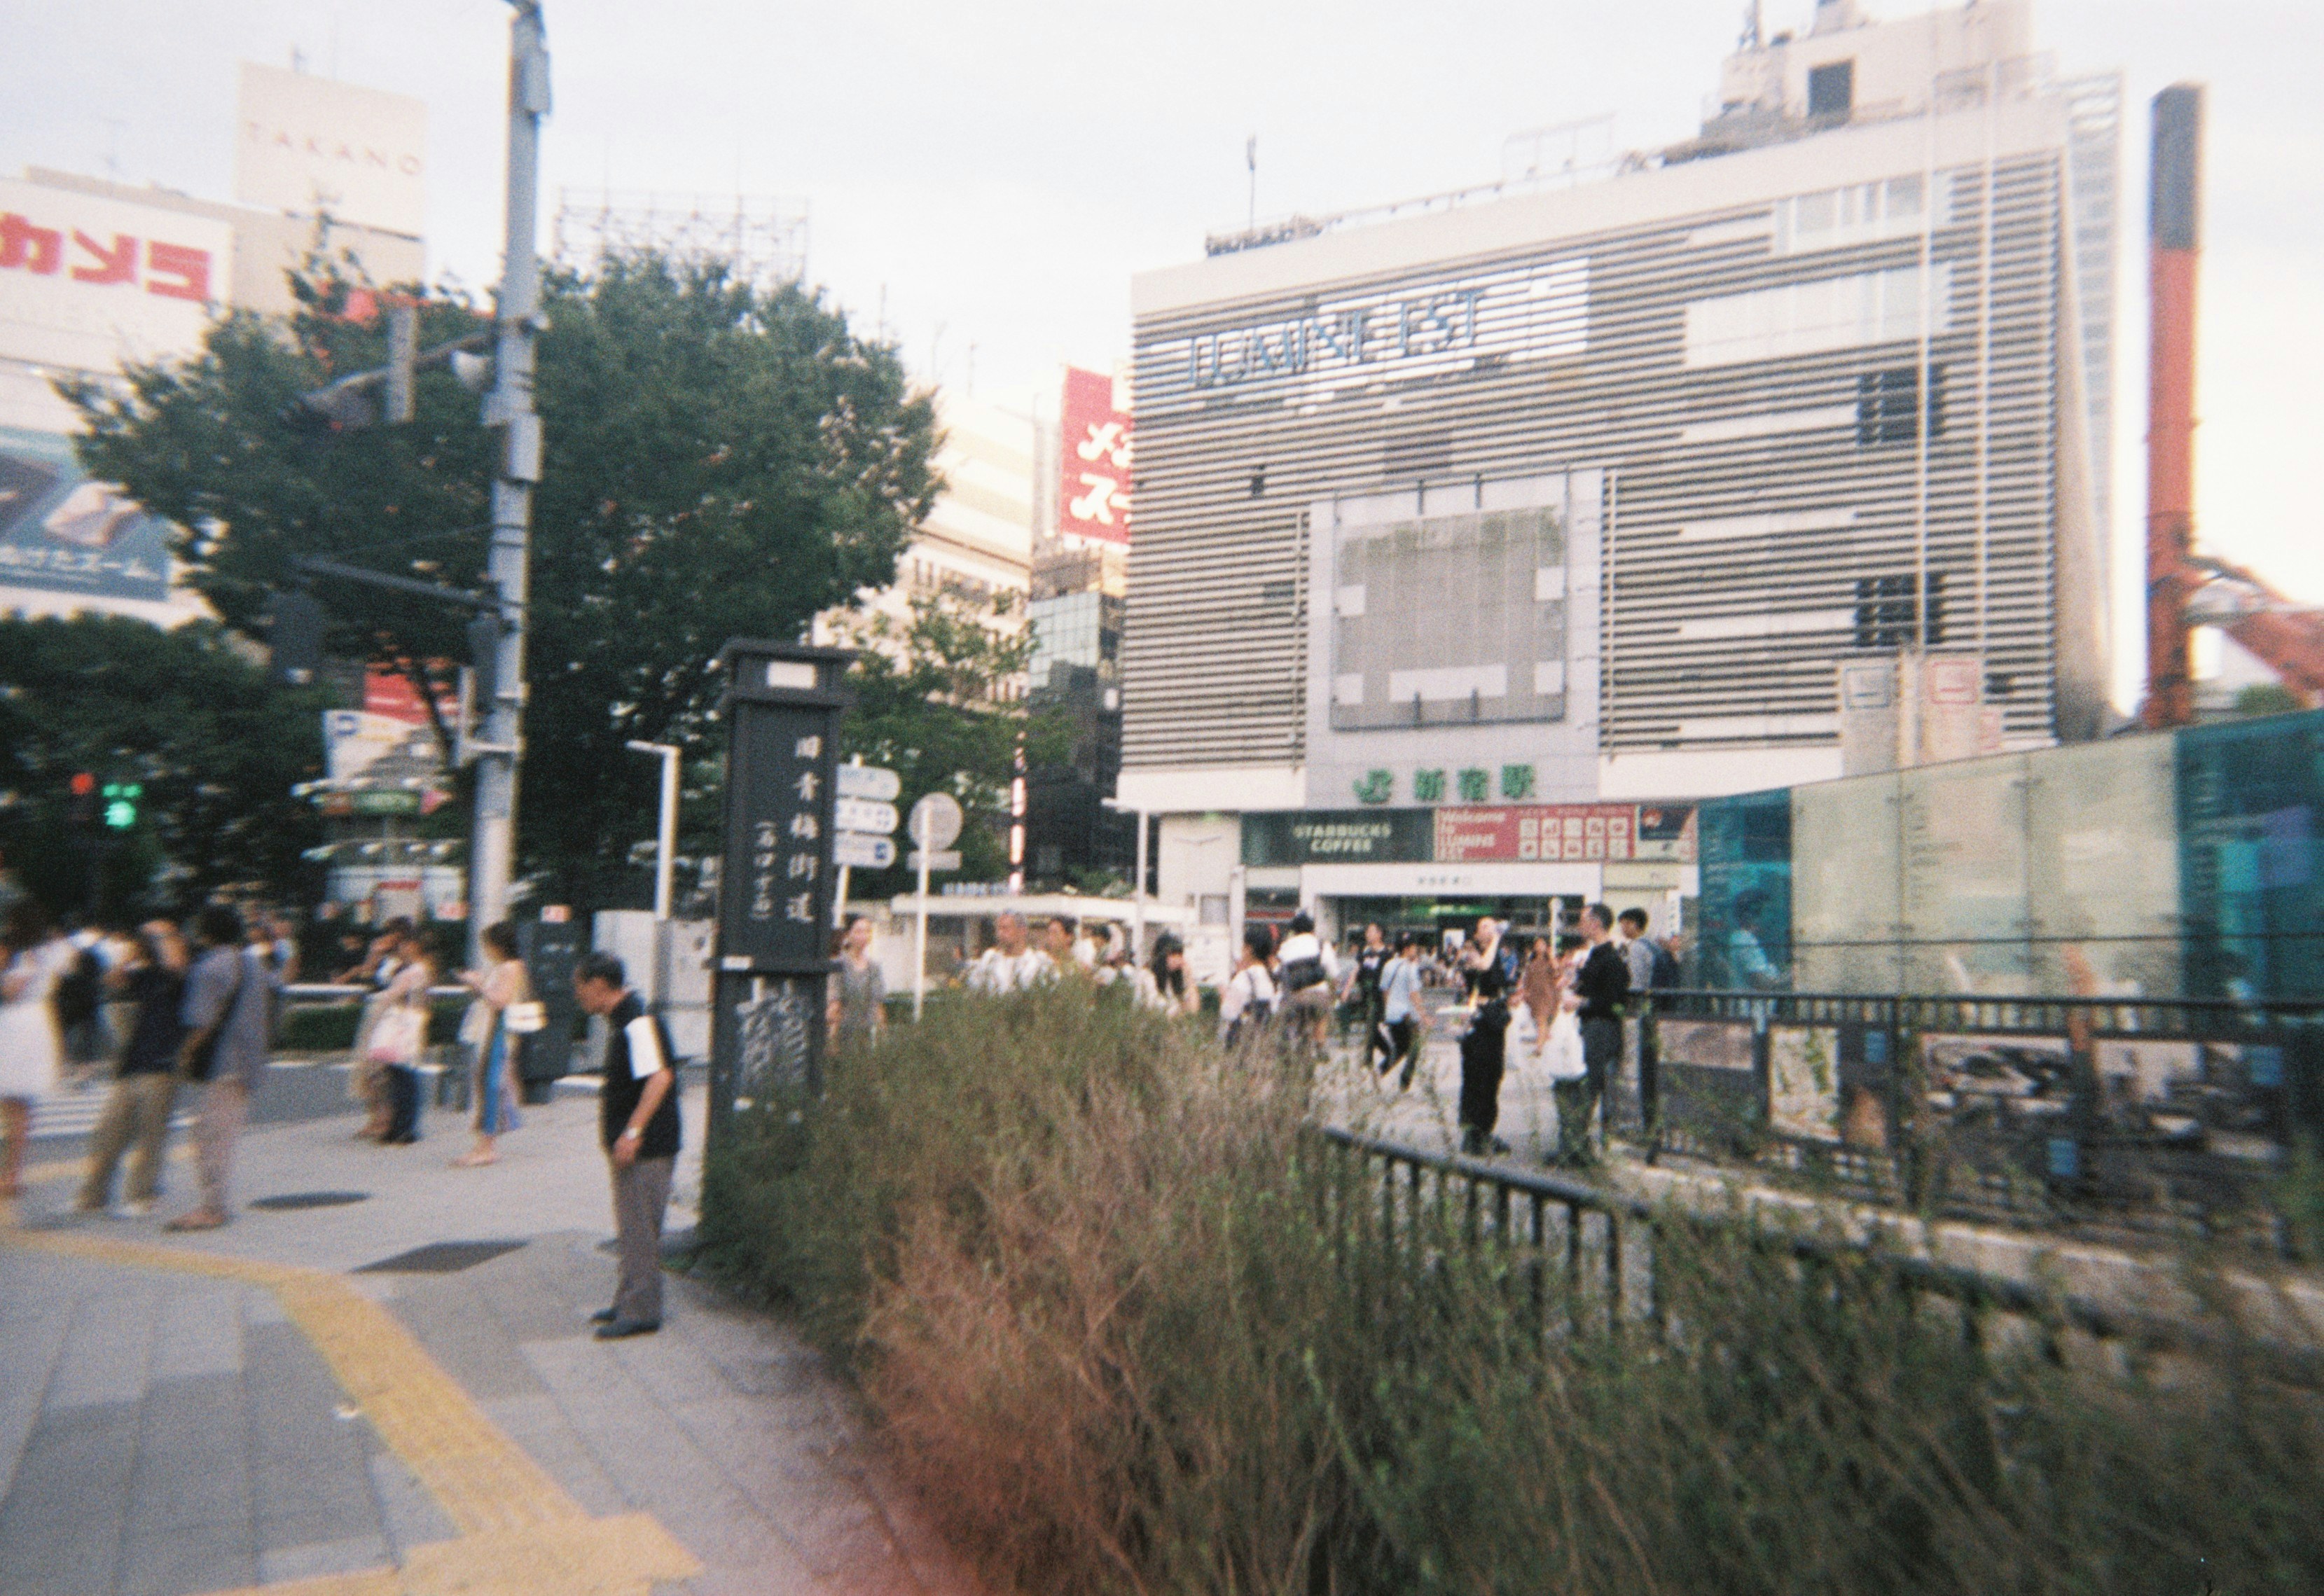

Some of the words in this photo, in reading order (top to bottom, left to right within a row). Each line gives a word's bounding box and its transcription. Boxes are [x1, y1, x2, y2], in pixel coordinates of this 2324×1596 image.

[245, 120, 424, 176] TAKANO
[1294, 822, 1392, 838] STARBUCKS
[1310, 838, 1371, 853] COFFEE
